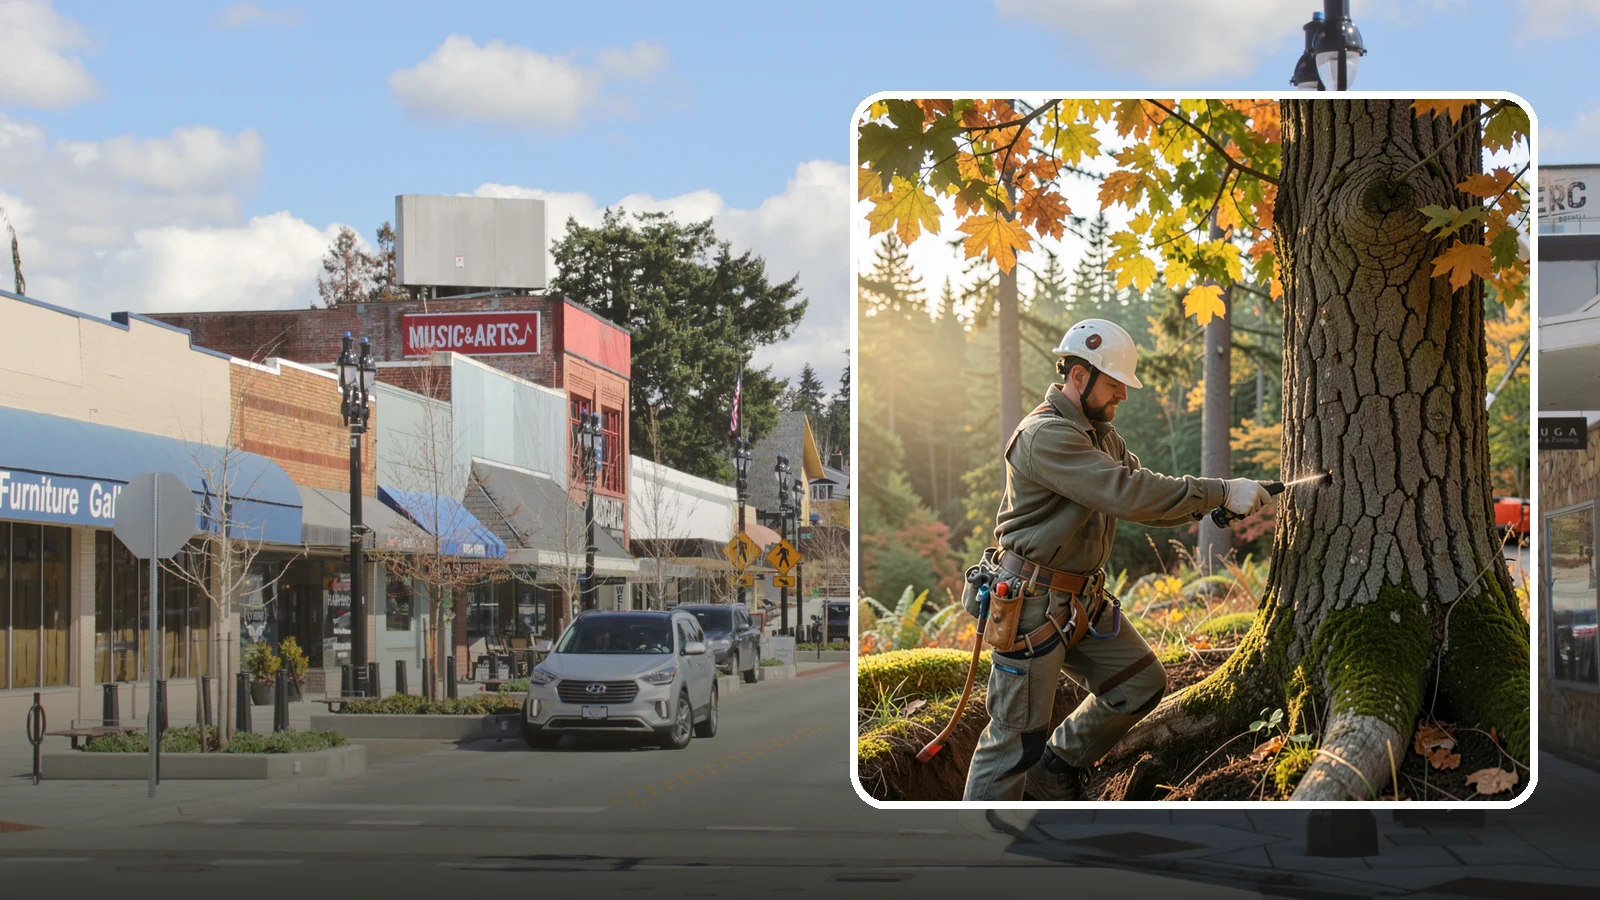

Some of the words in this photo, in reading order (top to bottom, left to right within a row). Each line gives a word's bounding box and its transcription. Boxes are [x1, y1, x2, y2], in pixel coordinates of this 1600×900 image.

[409, 323, 519, 348] MUSIC&ARTS
[1540, 428, 1577, 436] UGA
[0, 471, 79, 515] Furniture
[89, 482, 122, 519] Gal
[453, 564, 479, 574] SUSHI
